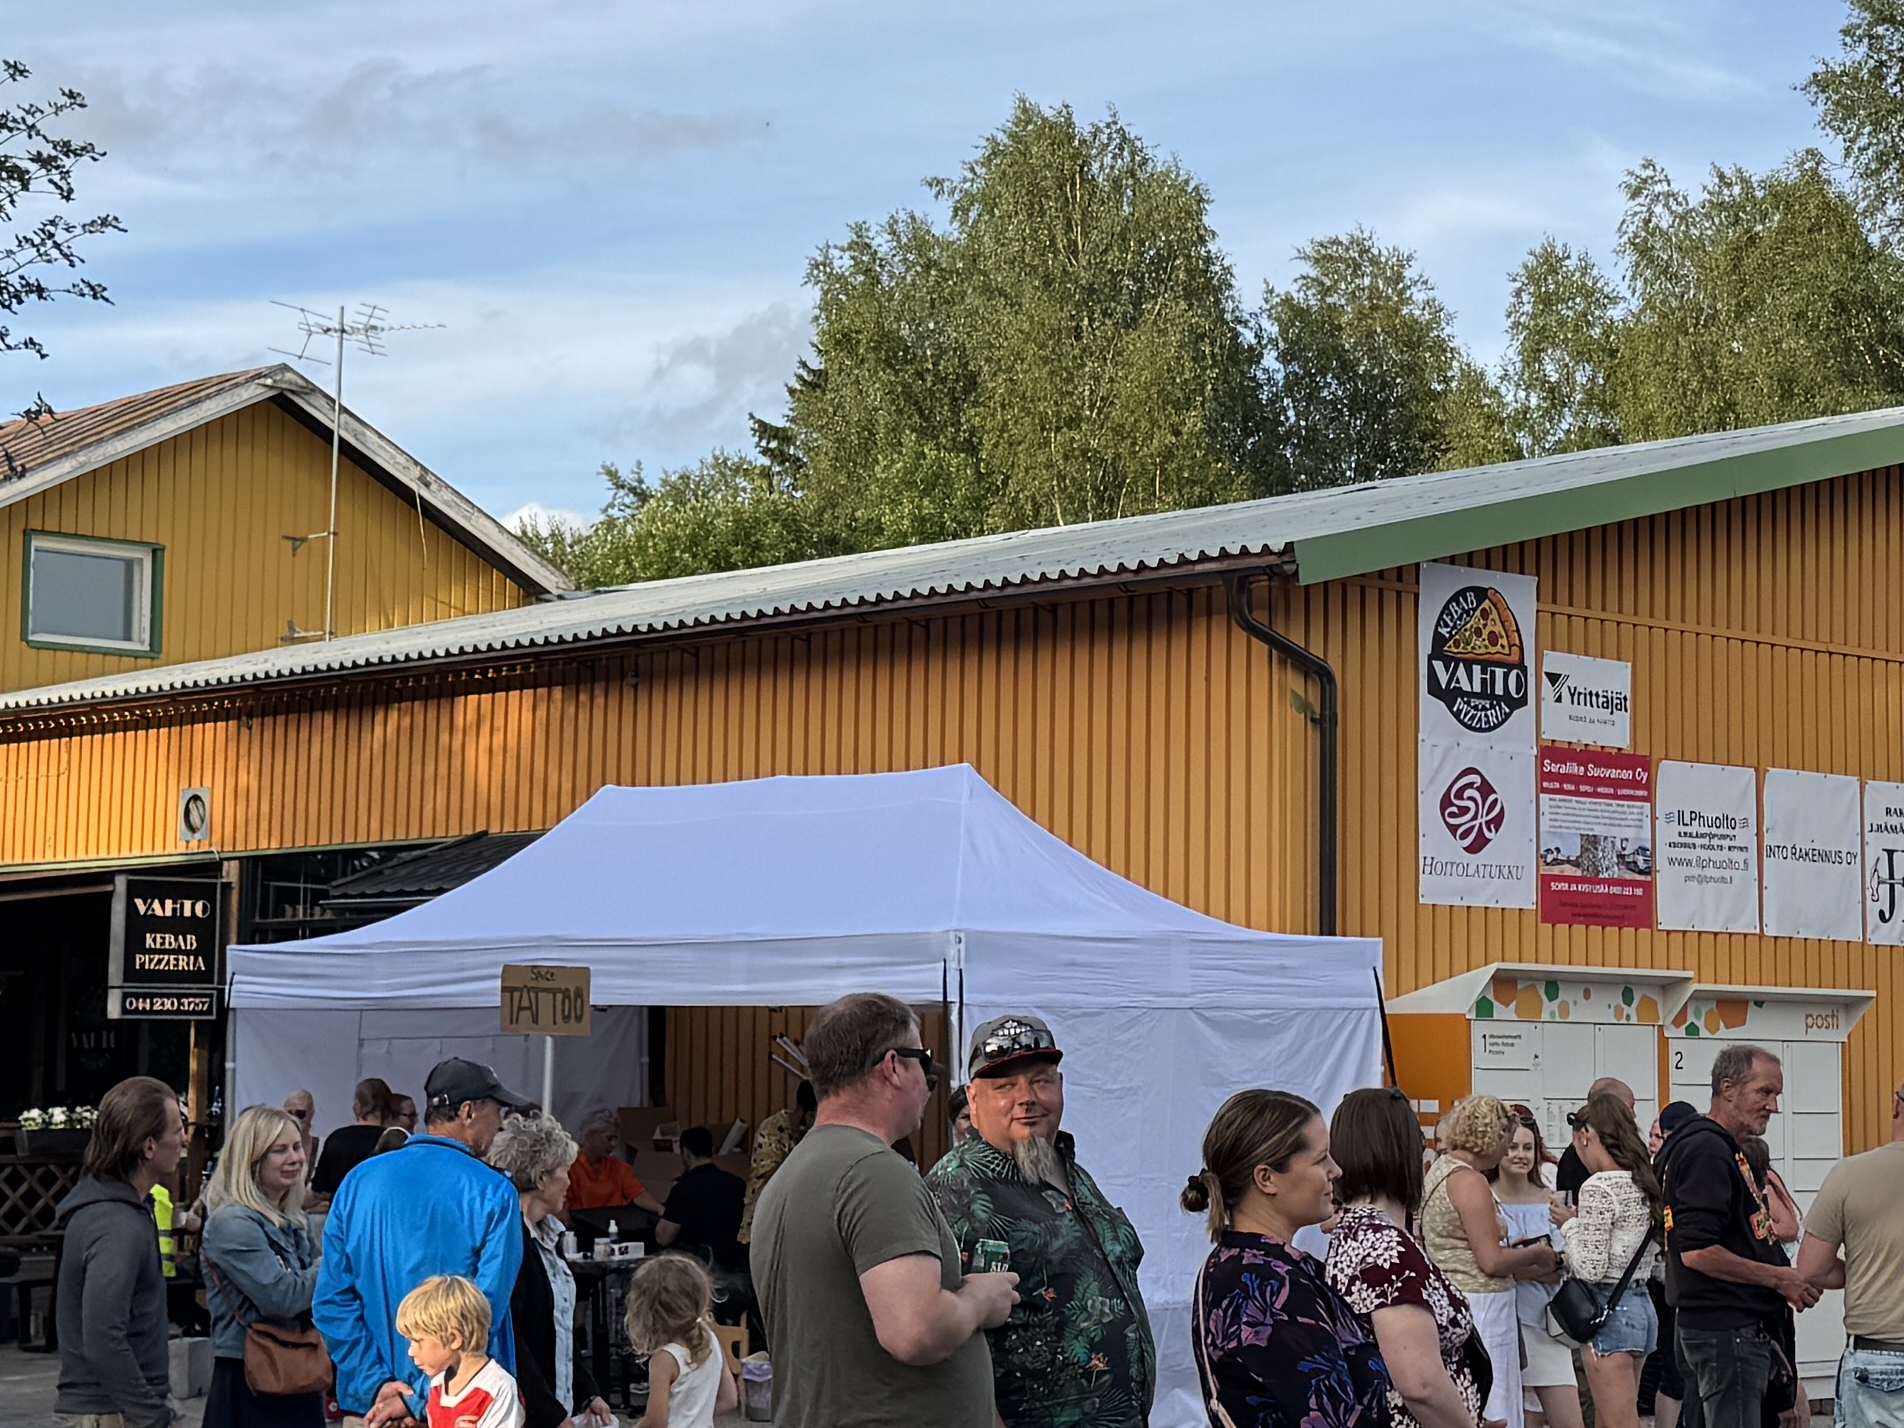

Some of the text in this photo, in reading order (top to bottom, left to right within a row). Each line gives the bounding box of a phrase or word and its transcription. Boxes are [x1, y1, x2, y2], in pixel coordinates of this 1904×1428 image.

[1437, 591, 1477, 638] KEBAB
[1431, 659, 1525, 699] VAHTO
[1567, 684, 1629, 716] Yrittäjät
[1453, 697, 1510, 729] PIZZERIA
[1635, 767, 1649, 784] Oy
[1677, 809, 1737, 830] ILPhuolto
[1790, 845, 1844, 865] RAKENNUS
[1845, 851, 1858, 865] OY
[133, 898, 211, 918] VAHTO
[145, 933, 198, 950] KEBAB
[136, 954, 206, 971] PIZZERIA
[152, 997, 178, 1011] 230
[501, 985, 584, 1026] TATTOO
[1805, 1009, 1840, 1035] posti
[1482, 1034, 1487, 1053] 1
[1674, 1051, 1684, 1070] 2
